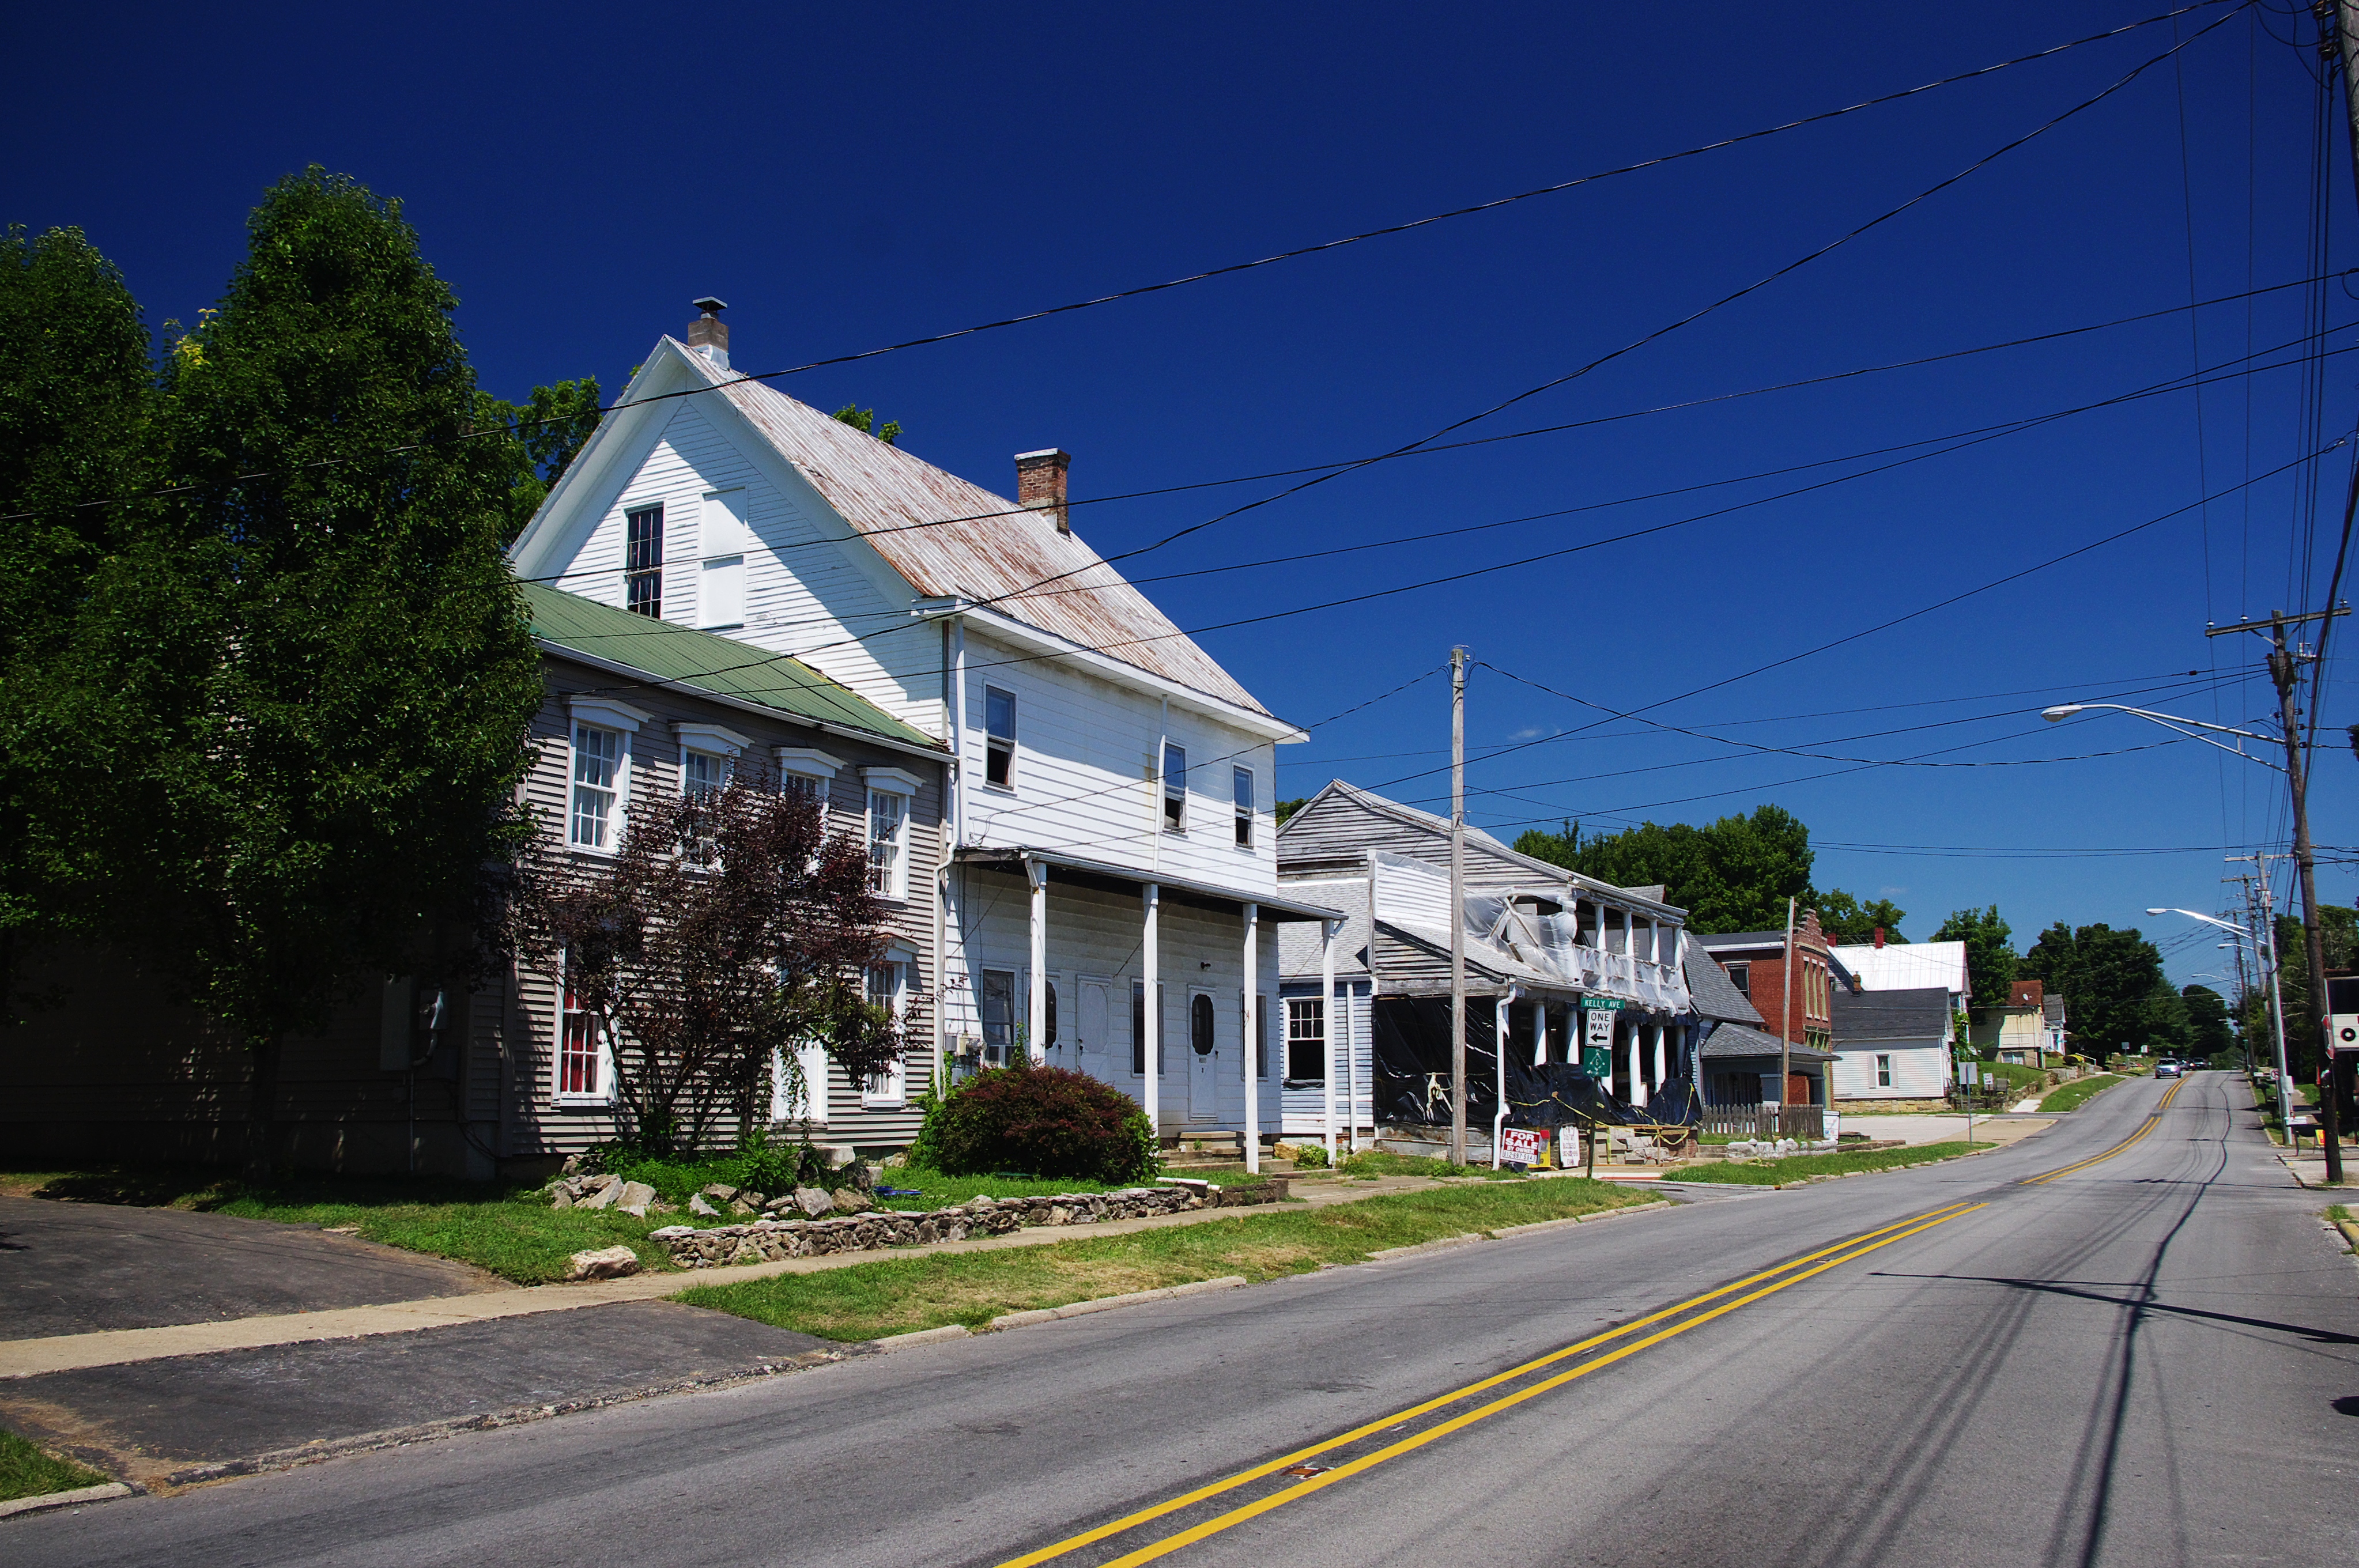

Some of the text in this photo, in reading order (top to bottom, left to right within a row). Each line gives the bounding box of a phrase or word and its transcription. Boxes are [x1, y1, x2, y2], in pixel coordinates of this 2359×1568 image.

[1584, 999, 1621, 1008] KELLY AVE
[1591, 1012, 1610, 1022] ONE
[1590, 1022, 1610, 1032] WAY
[1510, 1131, 1535, 1142] FOR
[1505, 1138, 1539, 1150] SALE
